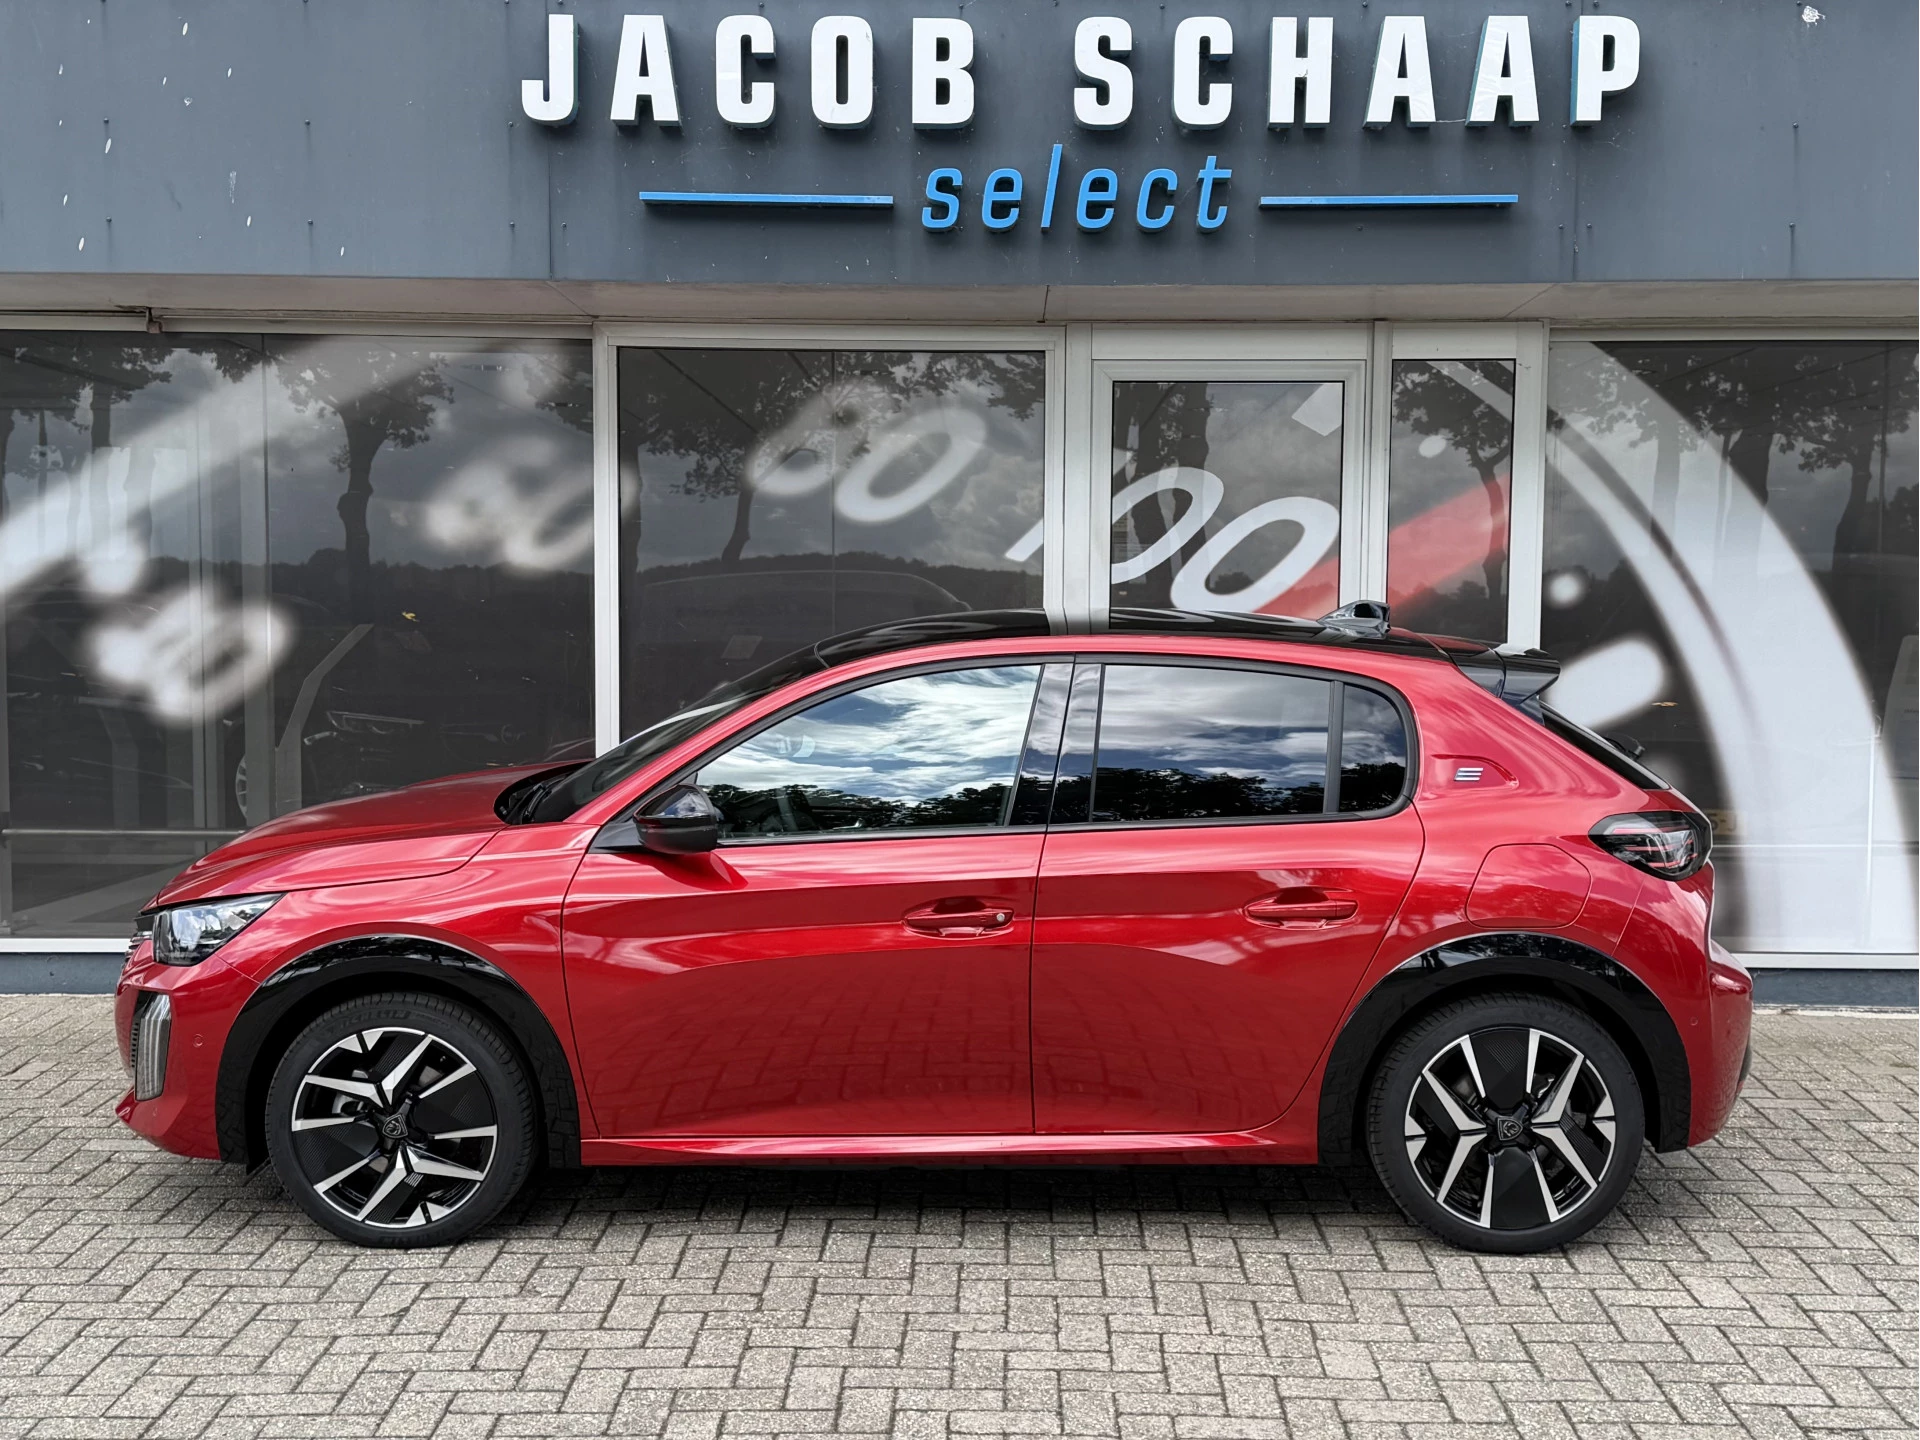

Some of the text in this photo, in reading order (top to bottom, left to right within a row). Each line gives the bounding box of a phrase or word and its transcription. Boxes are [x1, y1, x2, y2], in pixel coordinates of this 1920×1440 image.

[521, 14, 1640, 128] JACOB SCHAAP
[921, 143, 1232, 230] select
